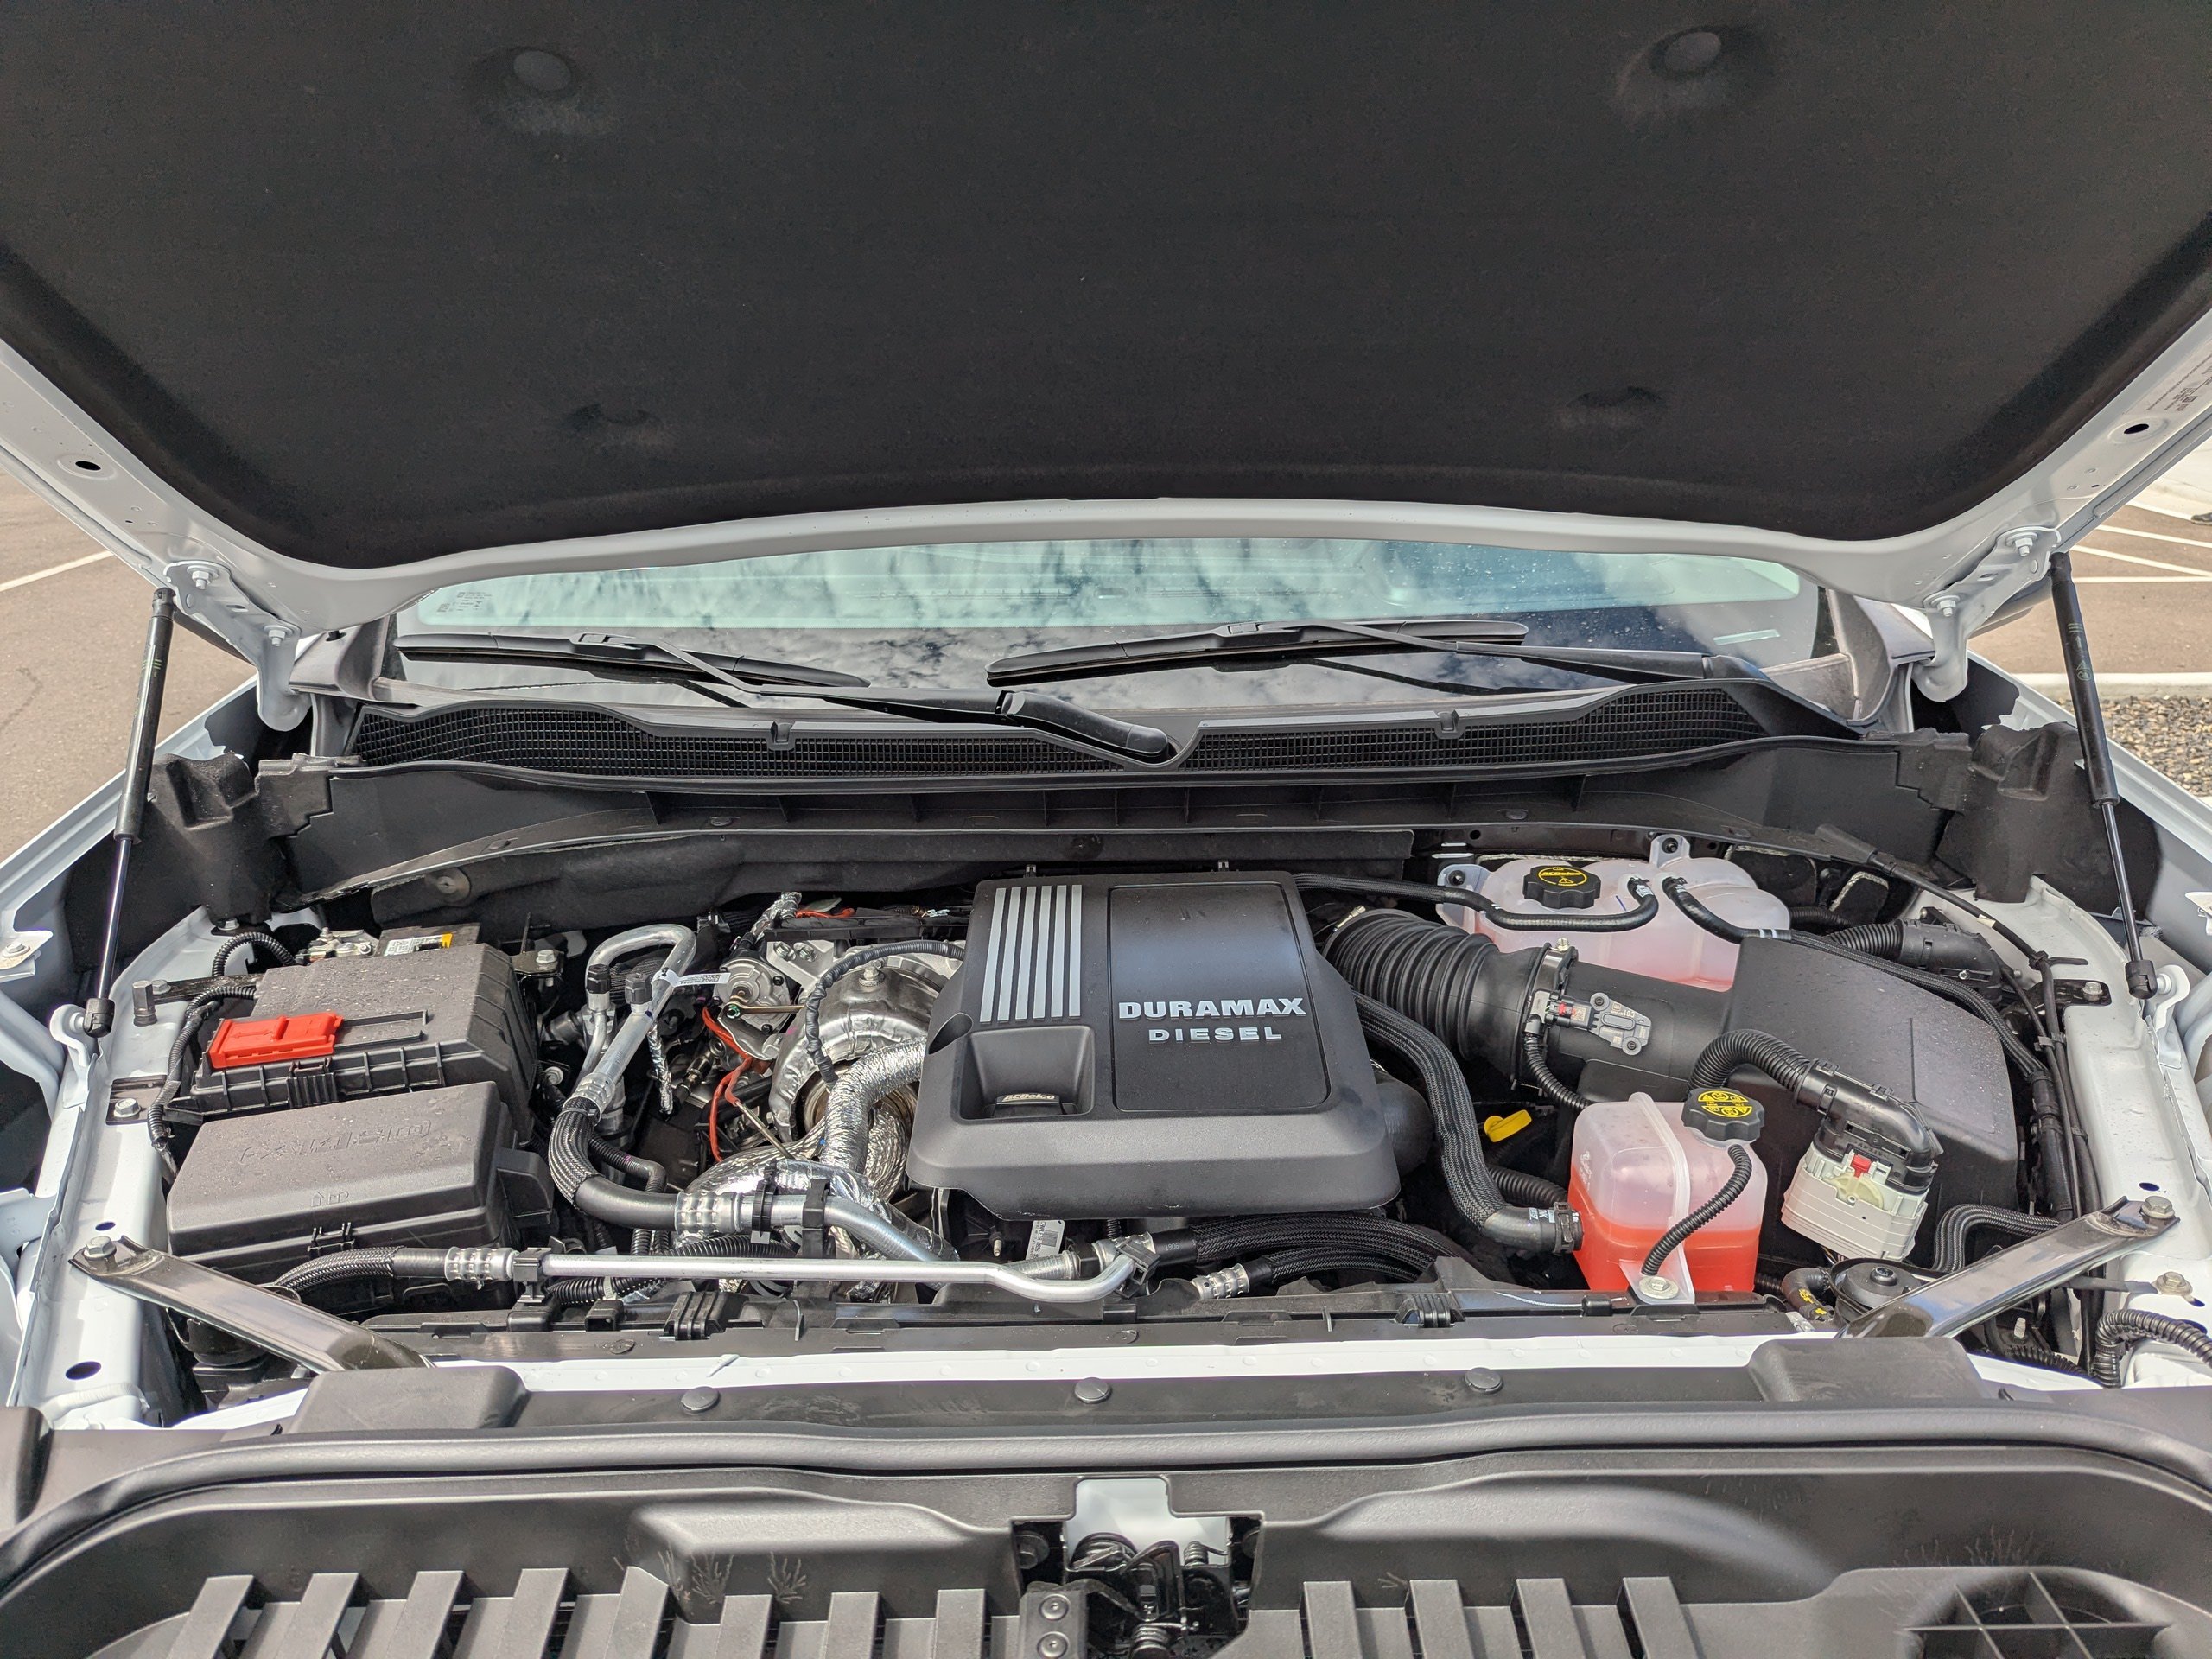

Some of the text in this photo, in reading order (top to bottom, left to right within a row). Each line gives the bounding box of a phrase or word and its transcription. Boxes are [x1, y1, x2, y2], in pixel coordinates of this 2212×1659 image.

[1118, 997, 1306, 1020] DURAMAX
[1148, 1027, 1282, 1043] DIESEL
[1002, 1093, 1055, 1102] ACDelco
